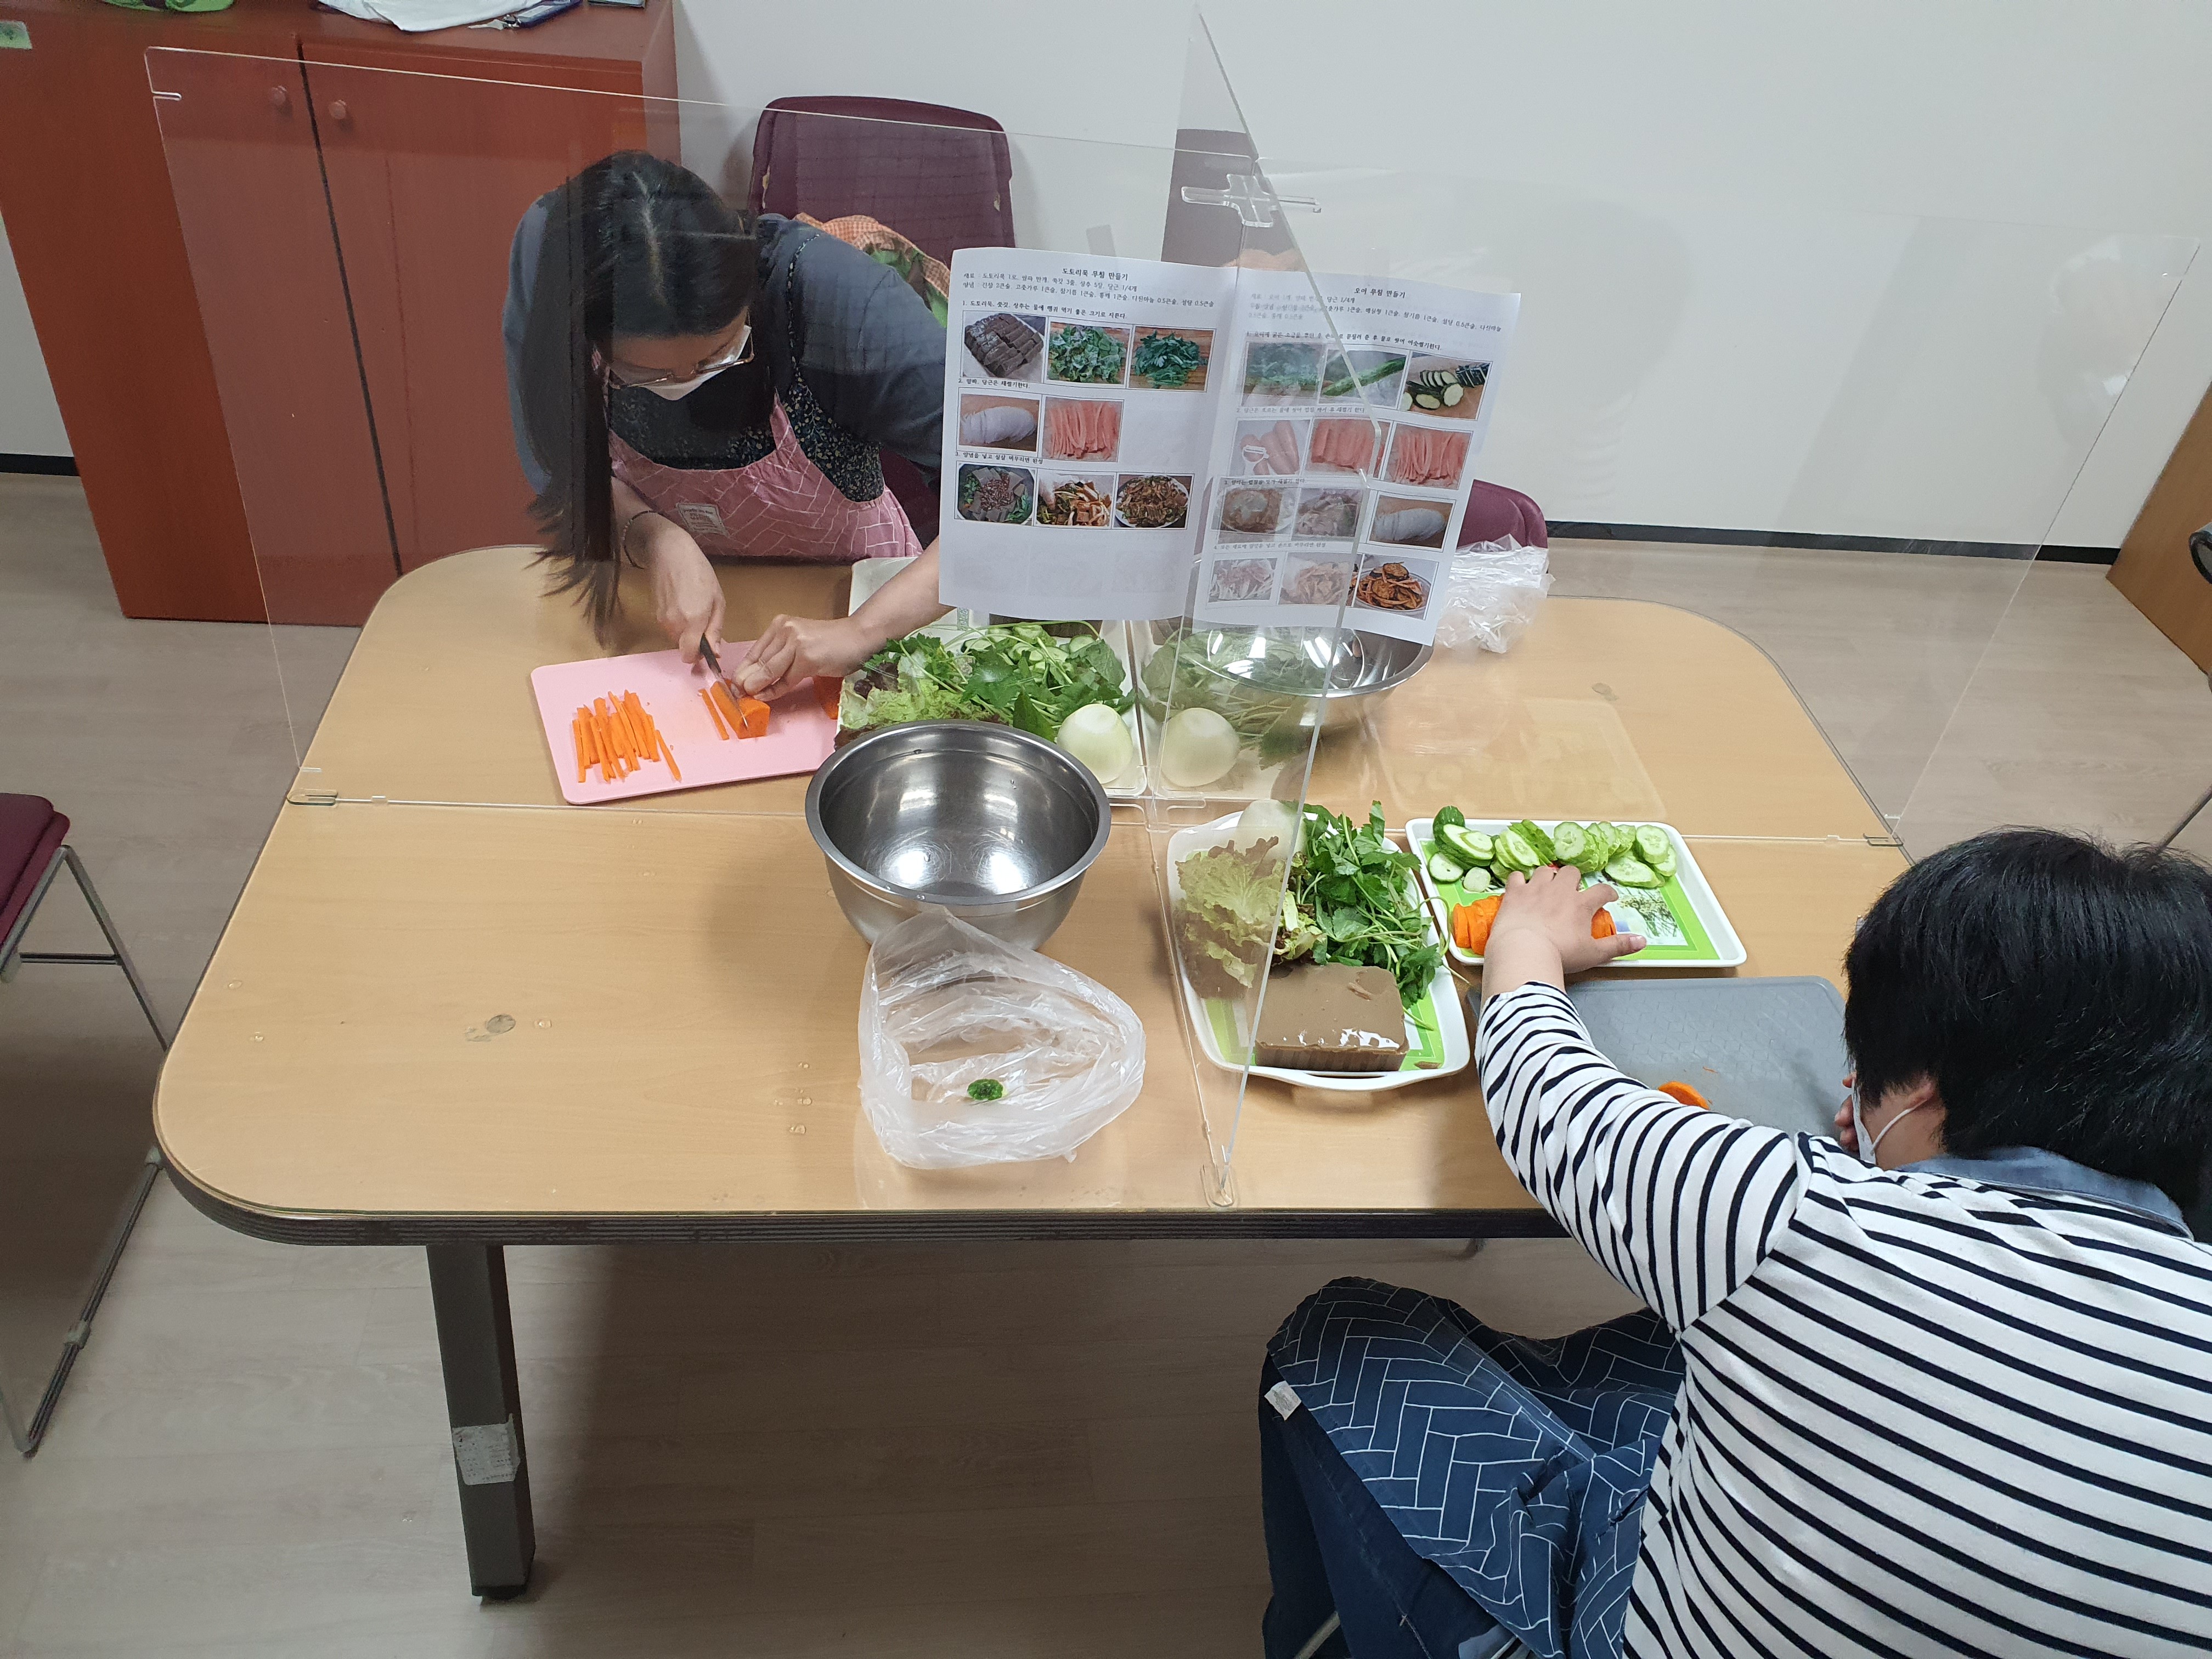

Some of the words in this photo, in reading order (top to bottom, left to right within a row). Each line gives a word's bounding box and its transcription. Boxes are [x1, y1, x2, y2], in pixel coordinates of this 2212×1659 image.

[1062, 268, 1088, 276] 도토리묵
[1092, 270, 1105, 279] 무침
[1109, 272, 1128, 281] 만들기
[1370, 289, 1383, 297] 무침
[1386, 290, 1406, 299] 만들기
